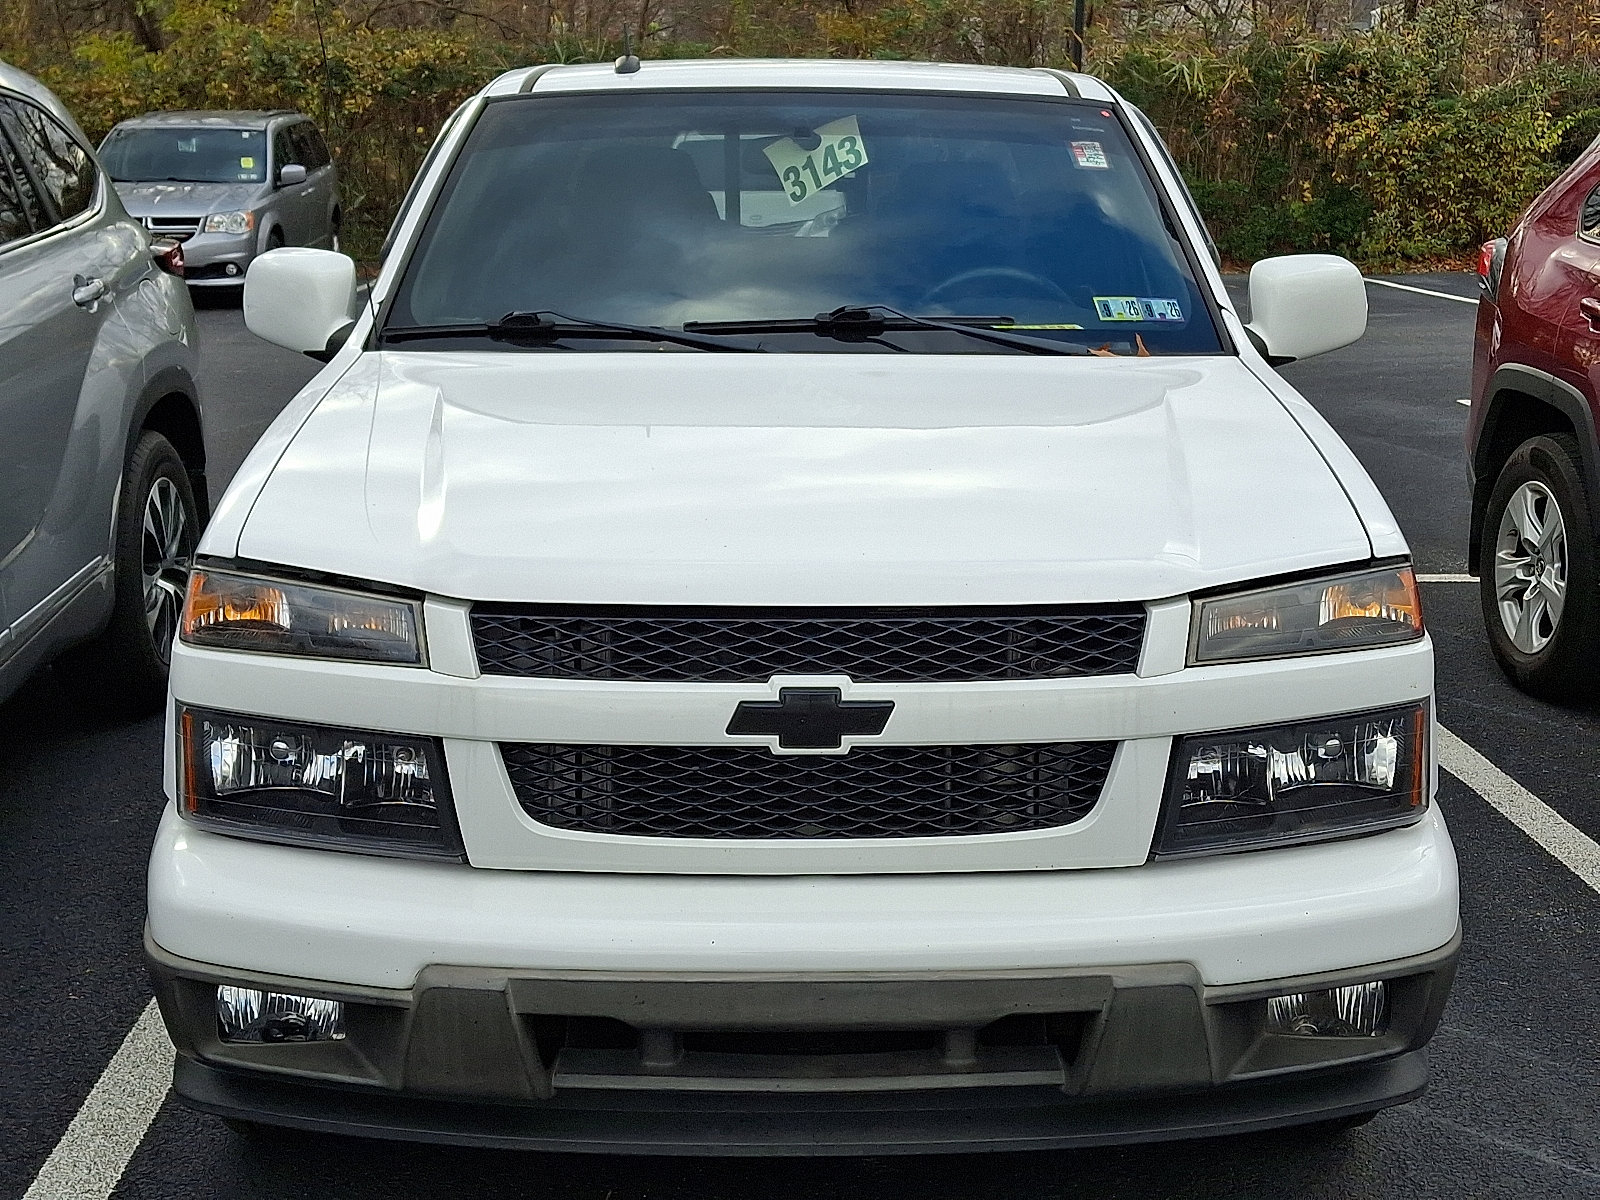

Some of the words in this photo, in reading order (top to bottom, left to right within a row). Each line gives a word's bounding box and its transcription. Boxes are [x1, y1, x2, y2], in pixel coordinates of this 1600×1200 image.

[783, 136, 862, 202] 3143
[1125, 300, 1140, 316] 26
[1167, 301, 1181, 317] 26
